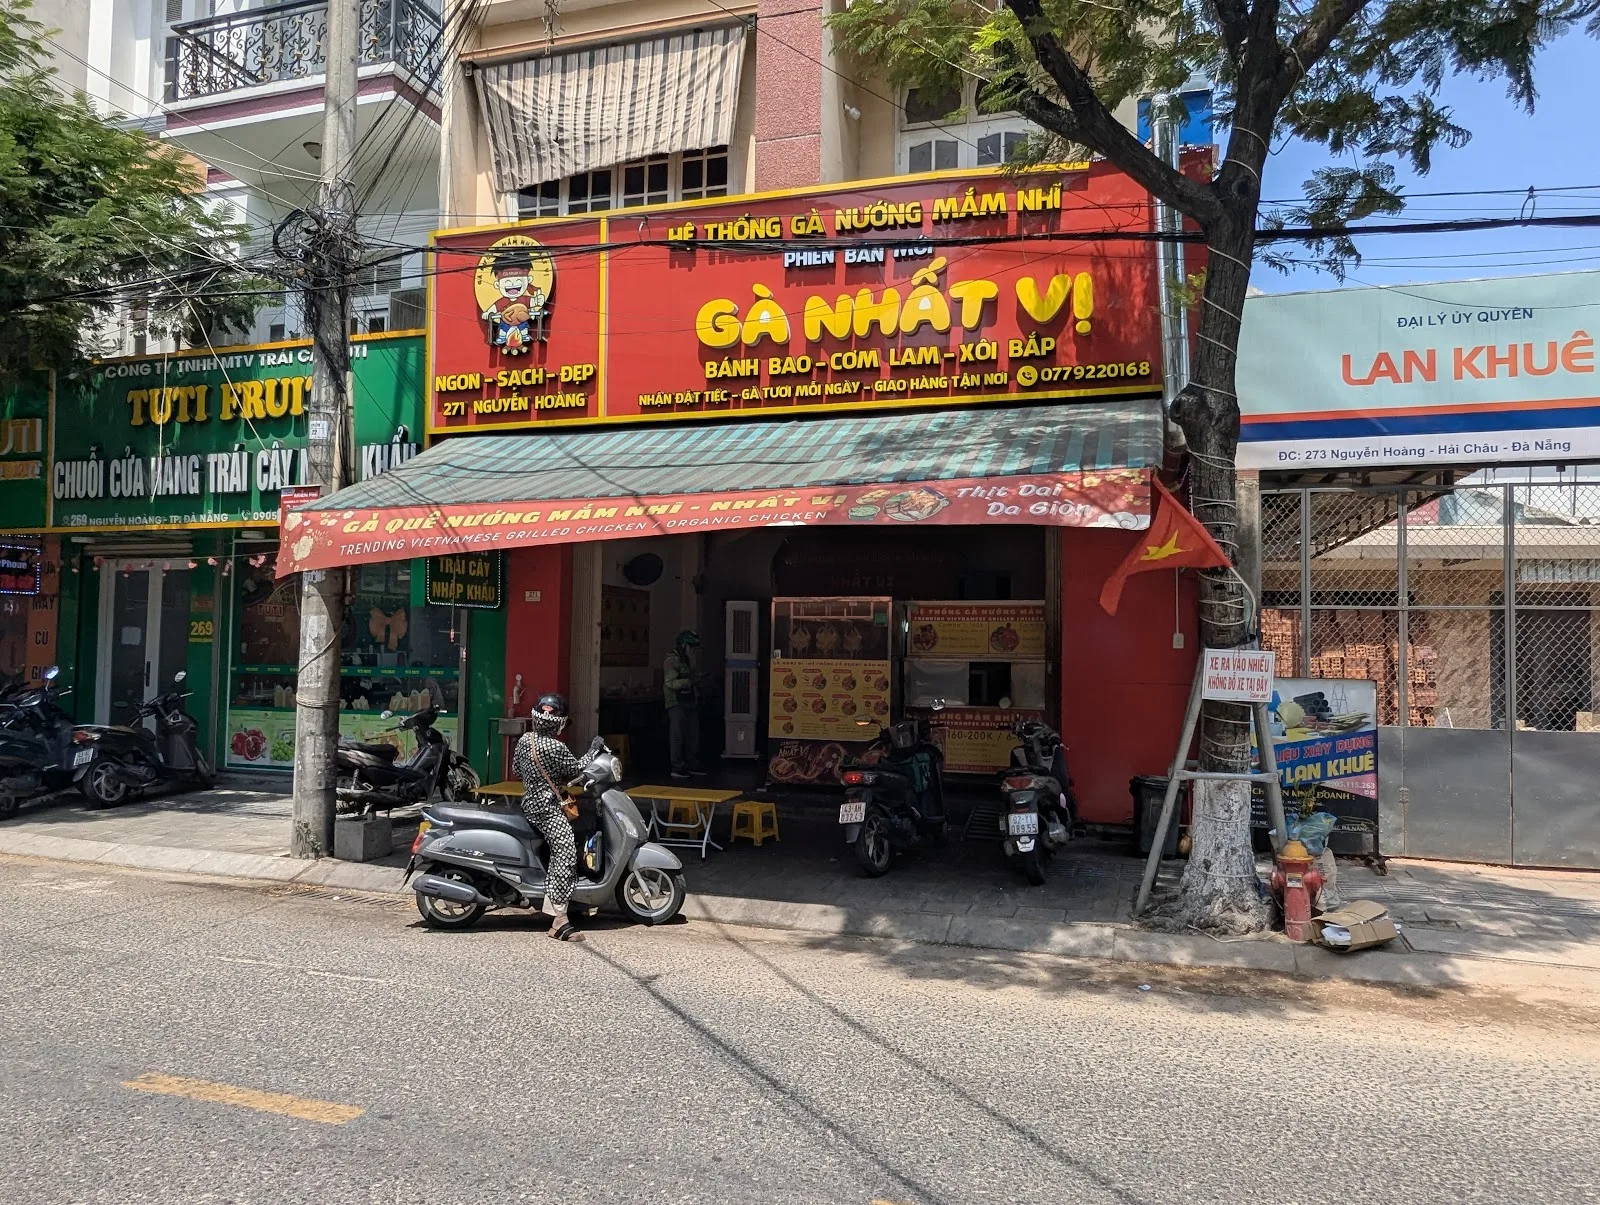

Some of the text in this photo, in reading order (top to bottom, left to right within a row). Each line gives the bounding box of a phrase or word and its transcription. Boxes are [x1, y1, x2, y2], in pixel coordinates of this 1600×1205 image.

[704, 212, 781, 240] THỐNG
[791, 208, 825, 235] GÀ
[835, 200, 921, 230] NƯỚNG
[932, 187, 1008, 220] MẮM
[696, 283, 791, 349] GÀ
[804, 256, 999, 342] NHẤT
[1397, 314, 1423, 330] ĐẠI
[1428, 311, 1447, 327] LÝ
[1452, 308, 1473, 324] ỦY
[105, 357, 152, 379] CÔNG
[156, 360, 174, 376] TY
[178, 358, 220, 374] TNHH
[222, 354, 254, 370] MTV
[258, 348, 294, 367] TRÁI
[704, 333, 1056, 378] BÁNH BAO CƠM LAM XÔI BẮP
[1342, 330, 1595, 386] LAN KHUÊ
[434, 363, 595, 392] NGON SẠCH ĐẸP
[639, 362, 1151, 408] NHẬN ĐẶT TIỆC GÀ TƯƠI MỖI NGÀY GIAO HÀNG TẬN NƠI 0779220168
[127, 384, 211, 427] TUTI
[443, 390, 586, 416] 271 NGUYỄN HOÀNG
[1278, 438, 1572, 462] ĐC: 273 Nguyễn Hoàng Hải Châu Đà Nẵng
[53, 446, 104, 499] CHUỖI
[109, 444, 145, 496] CỬA
[150, 447, 200, 496] HÀNG
[207, 442, 248, 494] TRÁI
[256, 440, 295, 492] CÂY
[956, 484, 1008, 500] Thịt
[71, 514, 88, 527] 269
[89, 512, 126, 526] NGUYỄN
[128, 512, 162, 526] HOÀNG
[184, 512, 198, 524] ĐÀ
[253, 512, 278, 522] 0905
[342, 512, 380, 534] GÀ
[385, 511, 442, 534] QUÊ
[444, 510, 540, 528] NƯỚNG
[546, 504, 618, 522] MẮM
[709, 494, 802, 512] NHẤT
[1029, 499, 1094, 518] Giòn
[340, 510, 828, 557] TRENDING VIETNAMESE GRILLED CHICKEN ORGANIC CHICKEN
[0, 560, 27, 569] Phone
[468, 558, 490, 578] CÂY
[257, 604, 284, 616] TUTI
[190, 621, 214, 636] 269
[1210, 656, 1219, 670] XE
[1221, 657, 1230, 670] RA
[1232, 654, 1246, 672] VÀO
[1208, 674, 1227, 690] KHÔNG
[1237, 677, 1245, 690] XE
[1256, 676, 1268, 692] ĐÂY
[1304, 741, 1332, 759] XÂY
[1336, 735, 1374, 754] DỤNG
[1286, 751, 1375, 784] LAN KHUÊ
[1011, 824, 1037, 834] 089.55
